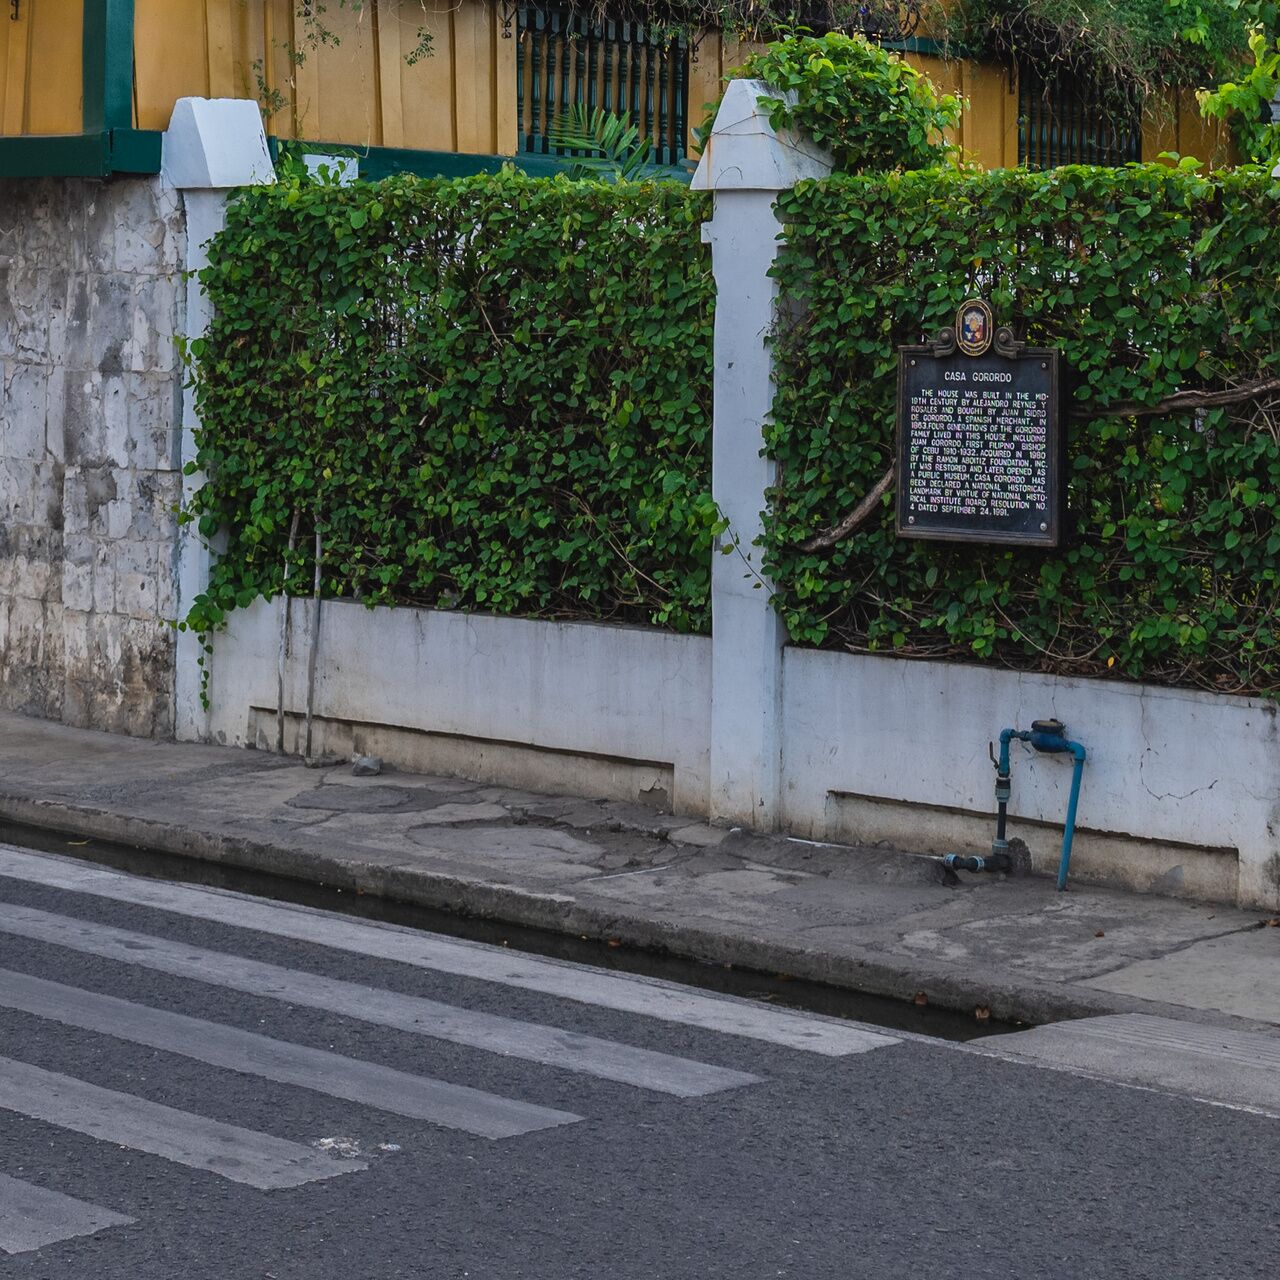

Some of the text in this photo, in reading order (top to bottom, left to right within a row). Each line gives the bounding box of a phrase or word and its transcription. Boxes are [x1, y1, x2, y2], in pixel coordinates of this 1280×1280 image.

[945, 371, 1012, 383] CASA GORORDO
[922, 389, 933, 397] THE
[983, 391, 1000, 399] BUILT
[1017, 392, 1029, 400] THE
[911, 397, 926, 405] 19TH
[930, 398, 957, 406] CENTURY
[973, 399, 1009, 407] ALEJANDRO
[911, 405, 937, 414] ROSALES
[942, 406, 954, 414] AND
[957, 407, 982, 415] BOUGHT
[1002, 408, 1019, 416] JUAN
[1024, 409, 1046, 417] ISIDRO
[958, 415, 962, 423] A
[965, 415, 992, 424] SPANISH
[1040, 418, 1046, 426] IN
[947, 423, 987, 432] GENERATIONS
[990, 424, 998, 432] OF
[1000, 425, 1012, 433] THE
[1015, 425, 1046, 434] GORORDO
[911, 430, 930, 438] FAMILY
[934, 431, 951, 439] LIVED
[966, 432, 980, 440] THIS
[1013, 434, 1046, 442] INCLUDING
[911, 438, 927, 446] JUAN
[966, 440, 983, 448] FIRST
[989, 441, 1015, 449] FILIPINO
[1022, 442, 1046, 451] BISHOP
[911, 446, 919, 454] OF
[923, 447, 939, 455] CEBU
[980, 449, 1011, 457] ACQUIRED
[1016, 450, 1022, 458] IN
[1030, 451, 1046, 459] 1980
[922, 455, 934, 463] THE
[937, 456, 958, 464] RAMON
[961, 457, 986, 465] ABOITIZ
[919, 463, 932, 471] WAS
[935, 464, 967, 472] RESTORED
[970, 465, 982, 473] AND
[985, 466, 1004, 474] LATER
[1007, 467, 1032, 475] OPENED
[1037, 468, 1046, 476] AS
[911, 471, 915, 479] A
[918, 471, 941, 480] PUBLIC
[974, 474, 991, 482] CASA
[994, 474, 1025, 483] GORORDO
[1032, 476, 1046, 484] HAS
[910, 479, 1046, 493] BEEN DECLARED A NATIONAL HISTORICAL
[910, 487, 942, 496] LANDMARK
[944, 489, 953, 497] BY
[956, 490, 978, 498] VIRTUE
[992, 491, 1021, 500] NATIONAL
[910, 495, 927, 504] RICAL
[930, 496, 961, 506] INSTITUTE
[965, 498, 987, 507] BOARD
[991, 499, 1030, 509] RESOLUTION
[910, 503, 914, 511] 4
[918, 504, 938, 513] DATED
[942, 505, 976, 514] SEPTEMBER
